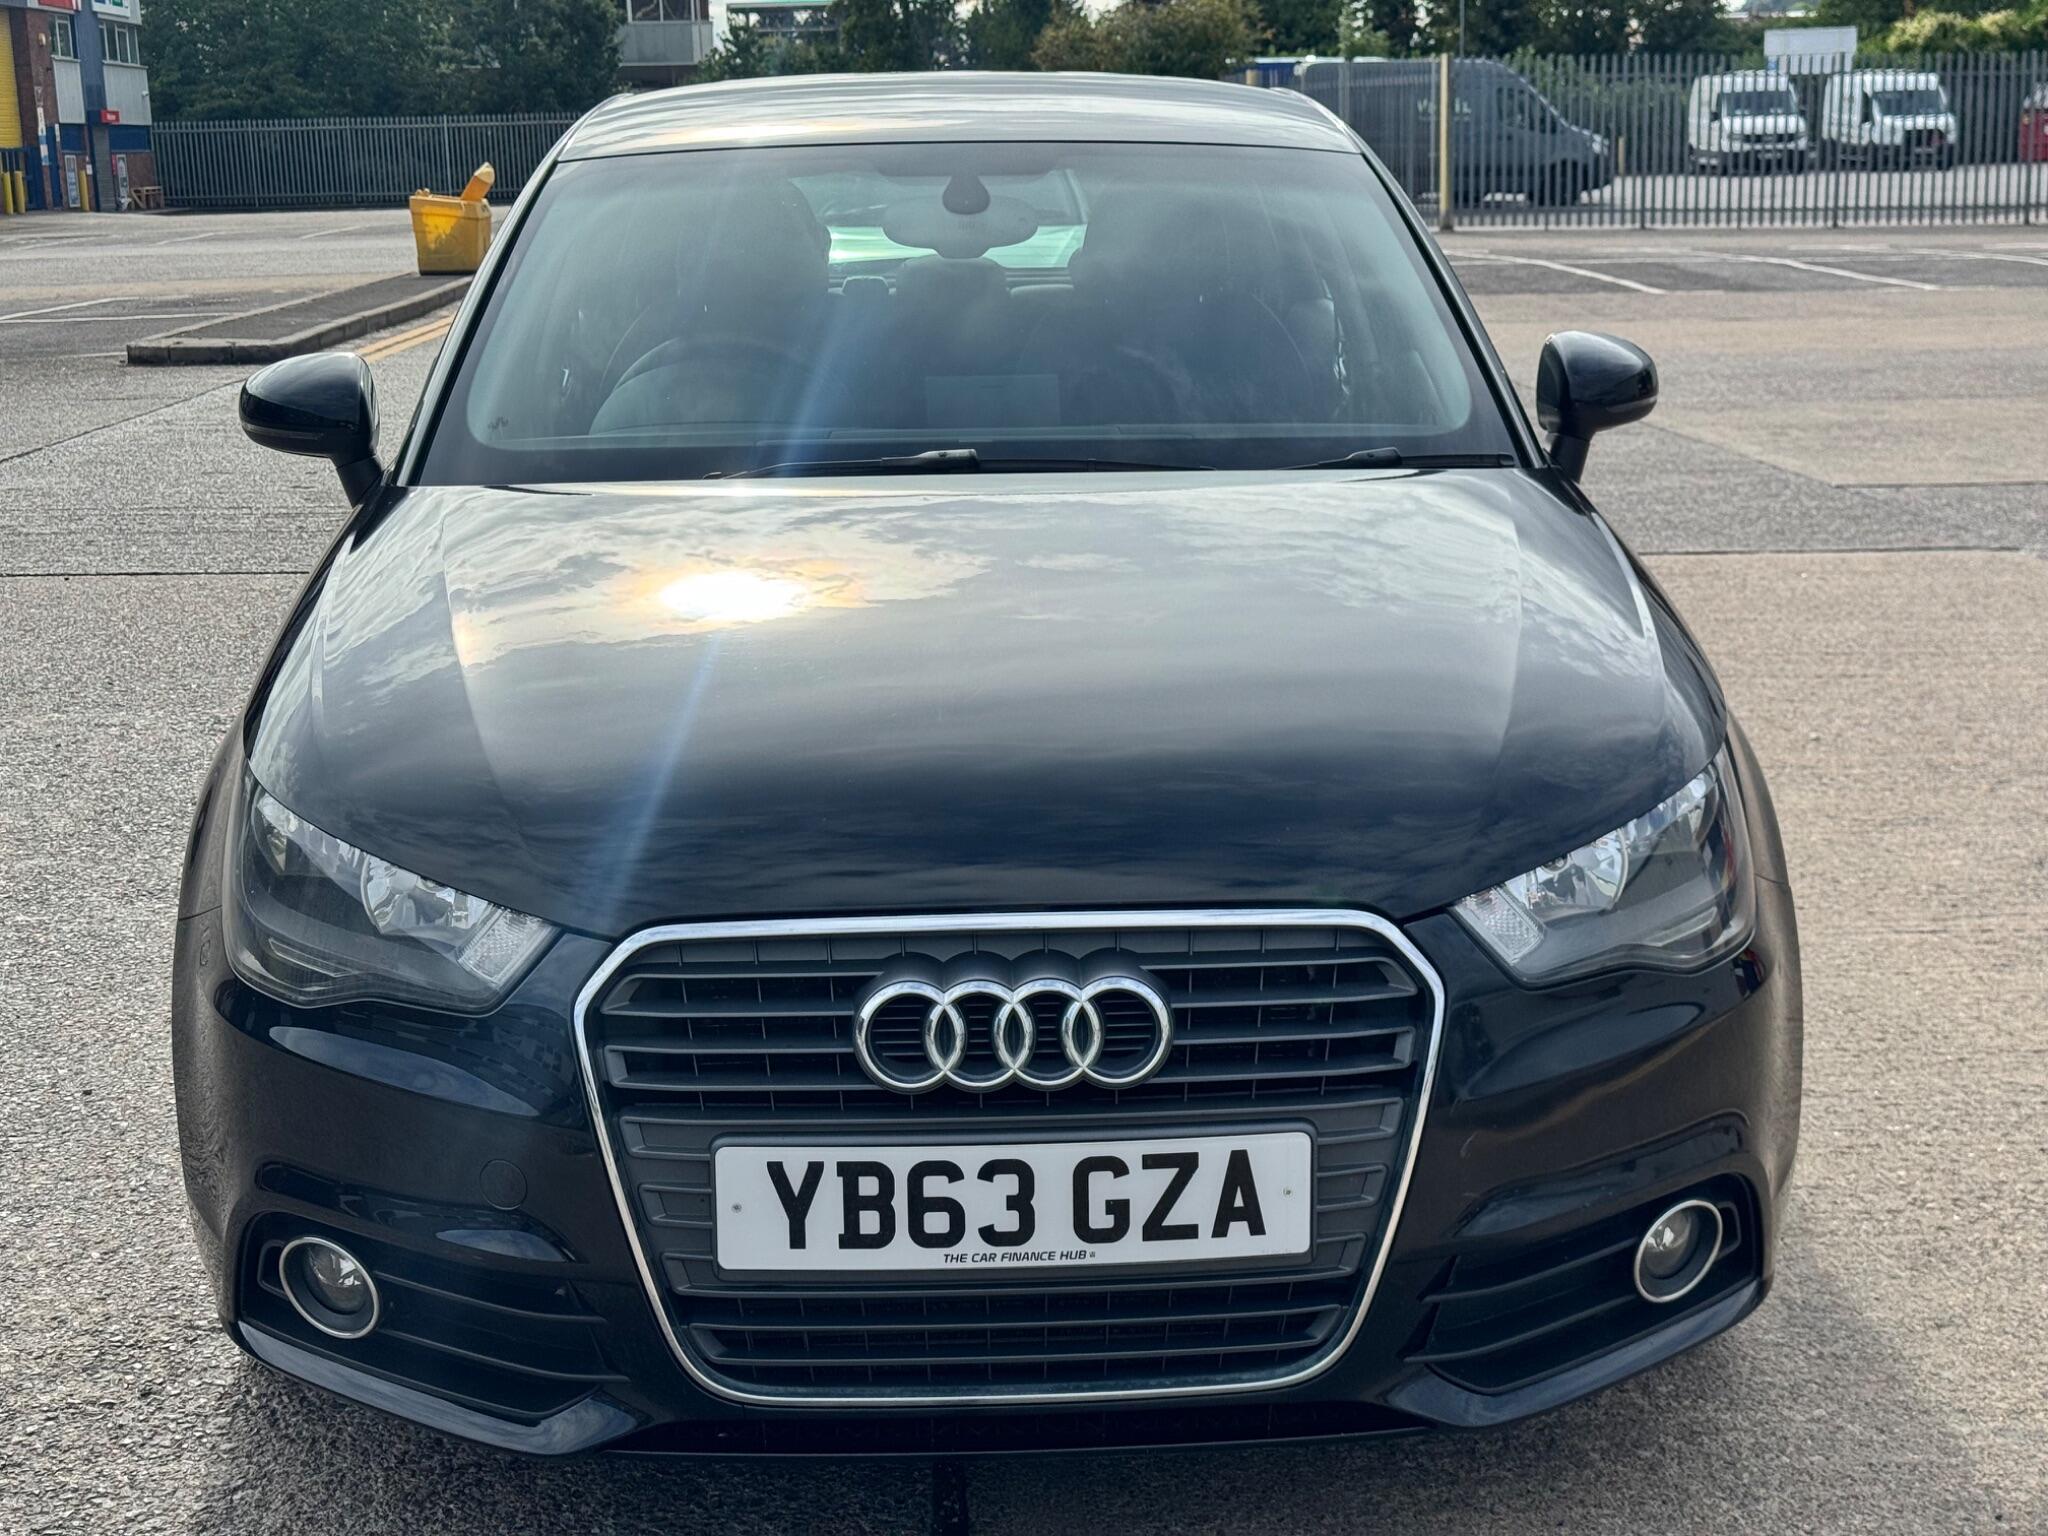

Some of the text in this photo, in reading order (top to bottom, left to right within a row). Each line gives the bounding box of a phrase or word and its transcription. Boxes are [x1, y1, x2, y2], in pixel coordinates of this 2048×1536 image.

[766, 1149, 1267, 1250] YB63 GZA
[943, 1253, 968, 1264] THE
[971, 1252, 997, 1263] CAR
[1000, 1250, 1056, 1262] FINANCE
[1059, 1249, 1087, 1261] HUB
